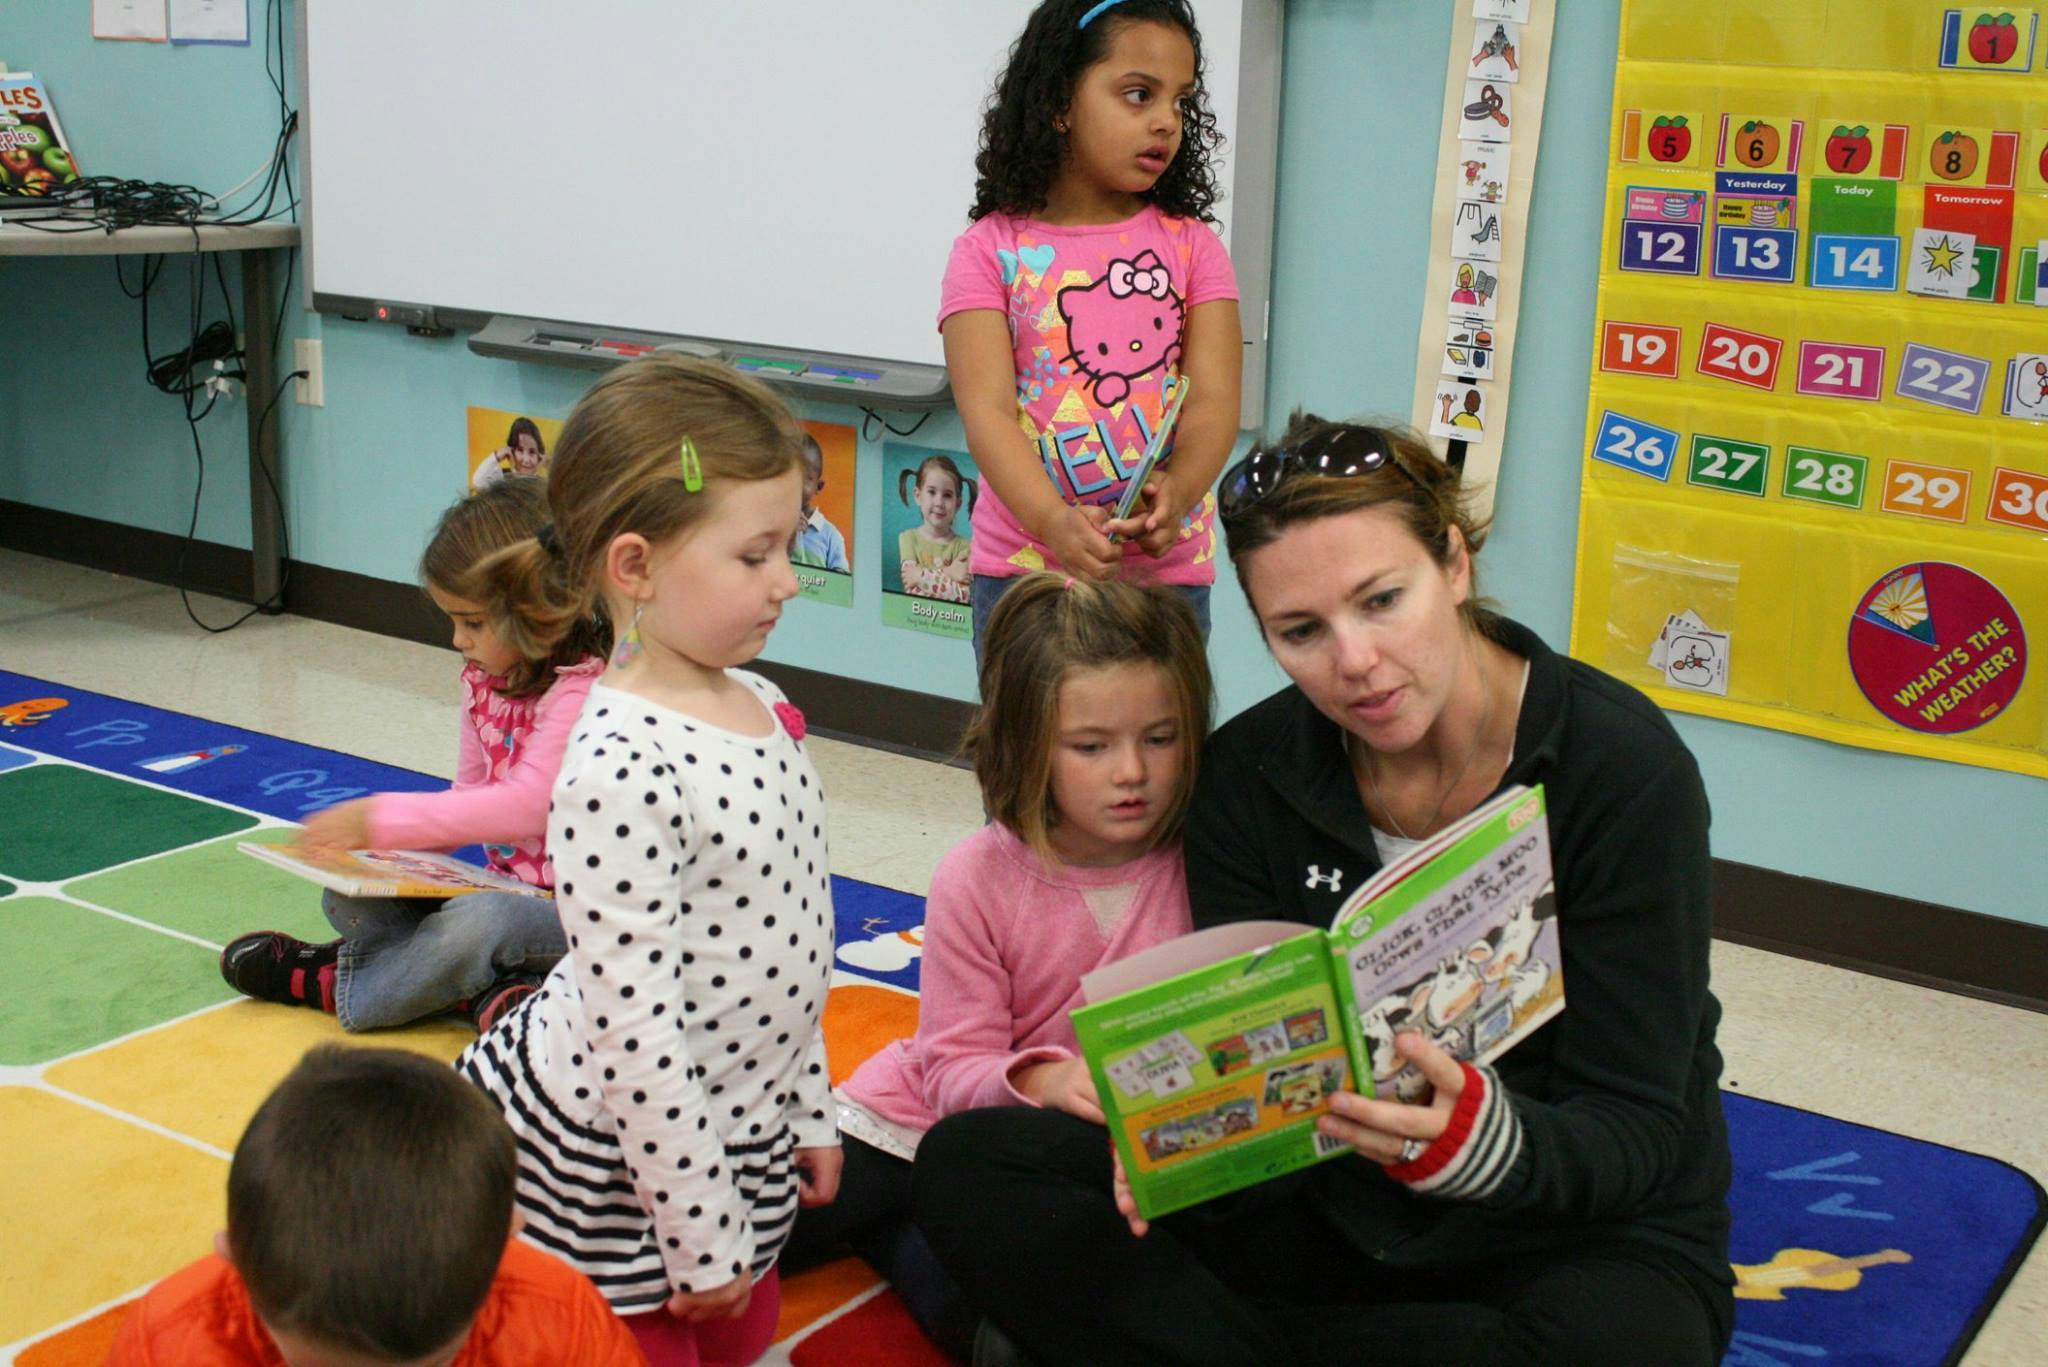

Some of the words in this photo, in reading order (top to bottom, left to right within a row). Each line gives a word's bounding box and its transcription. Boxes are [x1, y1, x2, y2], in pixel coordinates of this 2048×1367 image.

[1987, 37, 1997, 58] 1
[1662, 136, 1677, 158] 5
[1749, 139, 1764, 162] 6
[1841, 147, 1857, 170] 7
[1945, 150, 1961, 174] 8
[1725, 178, 1787, 192] Yesterday
[1834, 185, 1874, 197] Today
[1934, 193, 2004, 206] Tomorrow
[1637, 231, 1686, 264] 12
[1732, 237, 1780, 270] 13
[1829, 246, 1884, 279] 14
[1618, 333, 1667, 365] 19
[1711, 337, 1771, 377] 20
[1813, 353, 1863, 388] 21
[1909, 358, 1976, 400] 22
[1604, 426, 1664, 467] 26
[1698, 447, 1761, 481] 27
[1794, 458, 1855, 496] 28
[1893, 472, 1960, 509] 29
[800, 574, 825, 587] quiet
[912, 601, 938, 622] Body
[939, 608, 965, 623] calm
[1893, 647, 1970, 707] WHAT'S
[1966, 617, 2009, 651] THE
[1919, 646, 2017, 722] WEATHER?
[1497, 836, 1538, 872] MOO
[1374, 938, 1424, 976] Cows
[1428, 902, 1475, 938] That
[1480, 864, 1527, 900] Type
